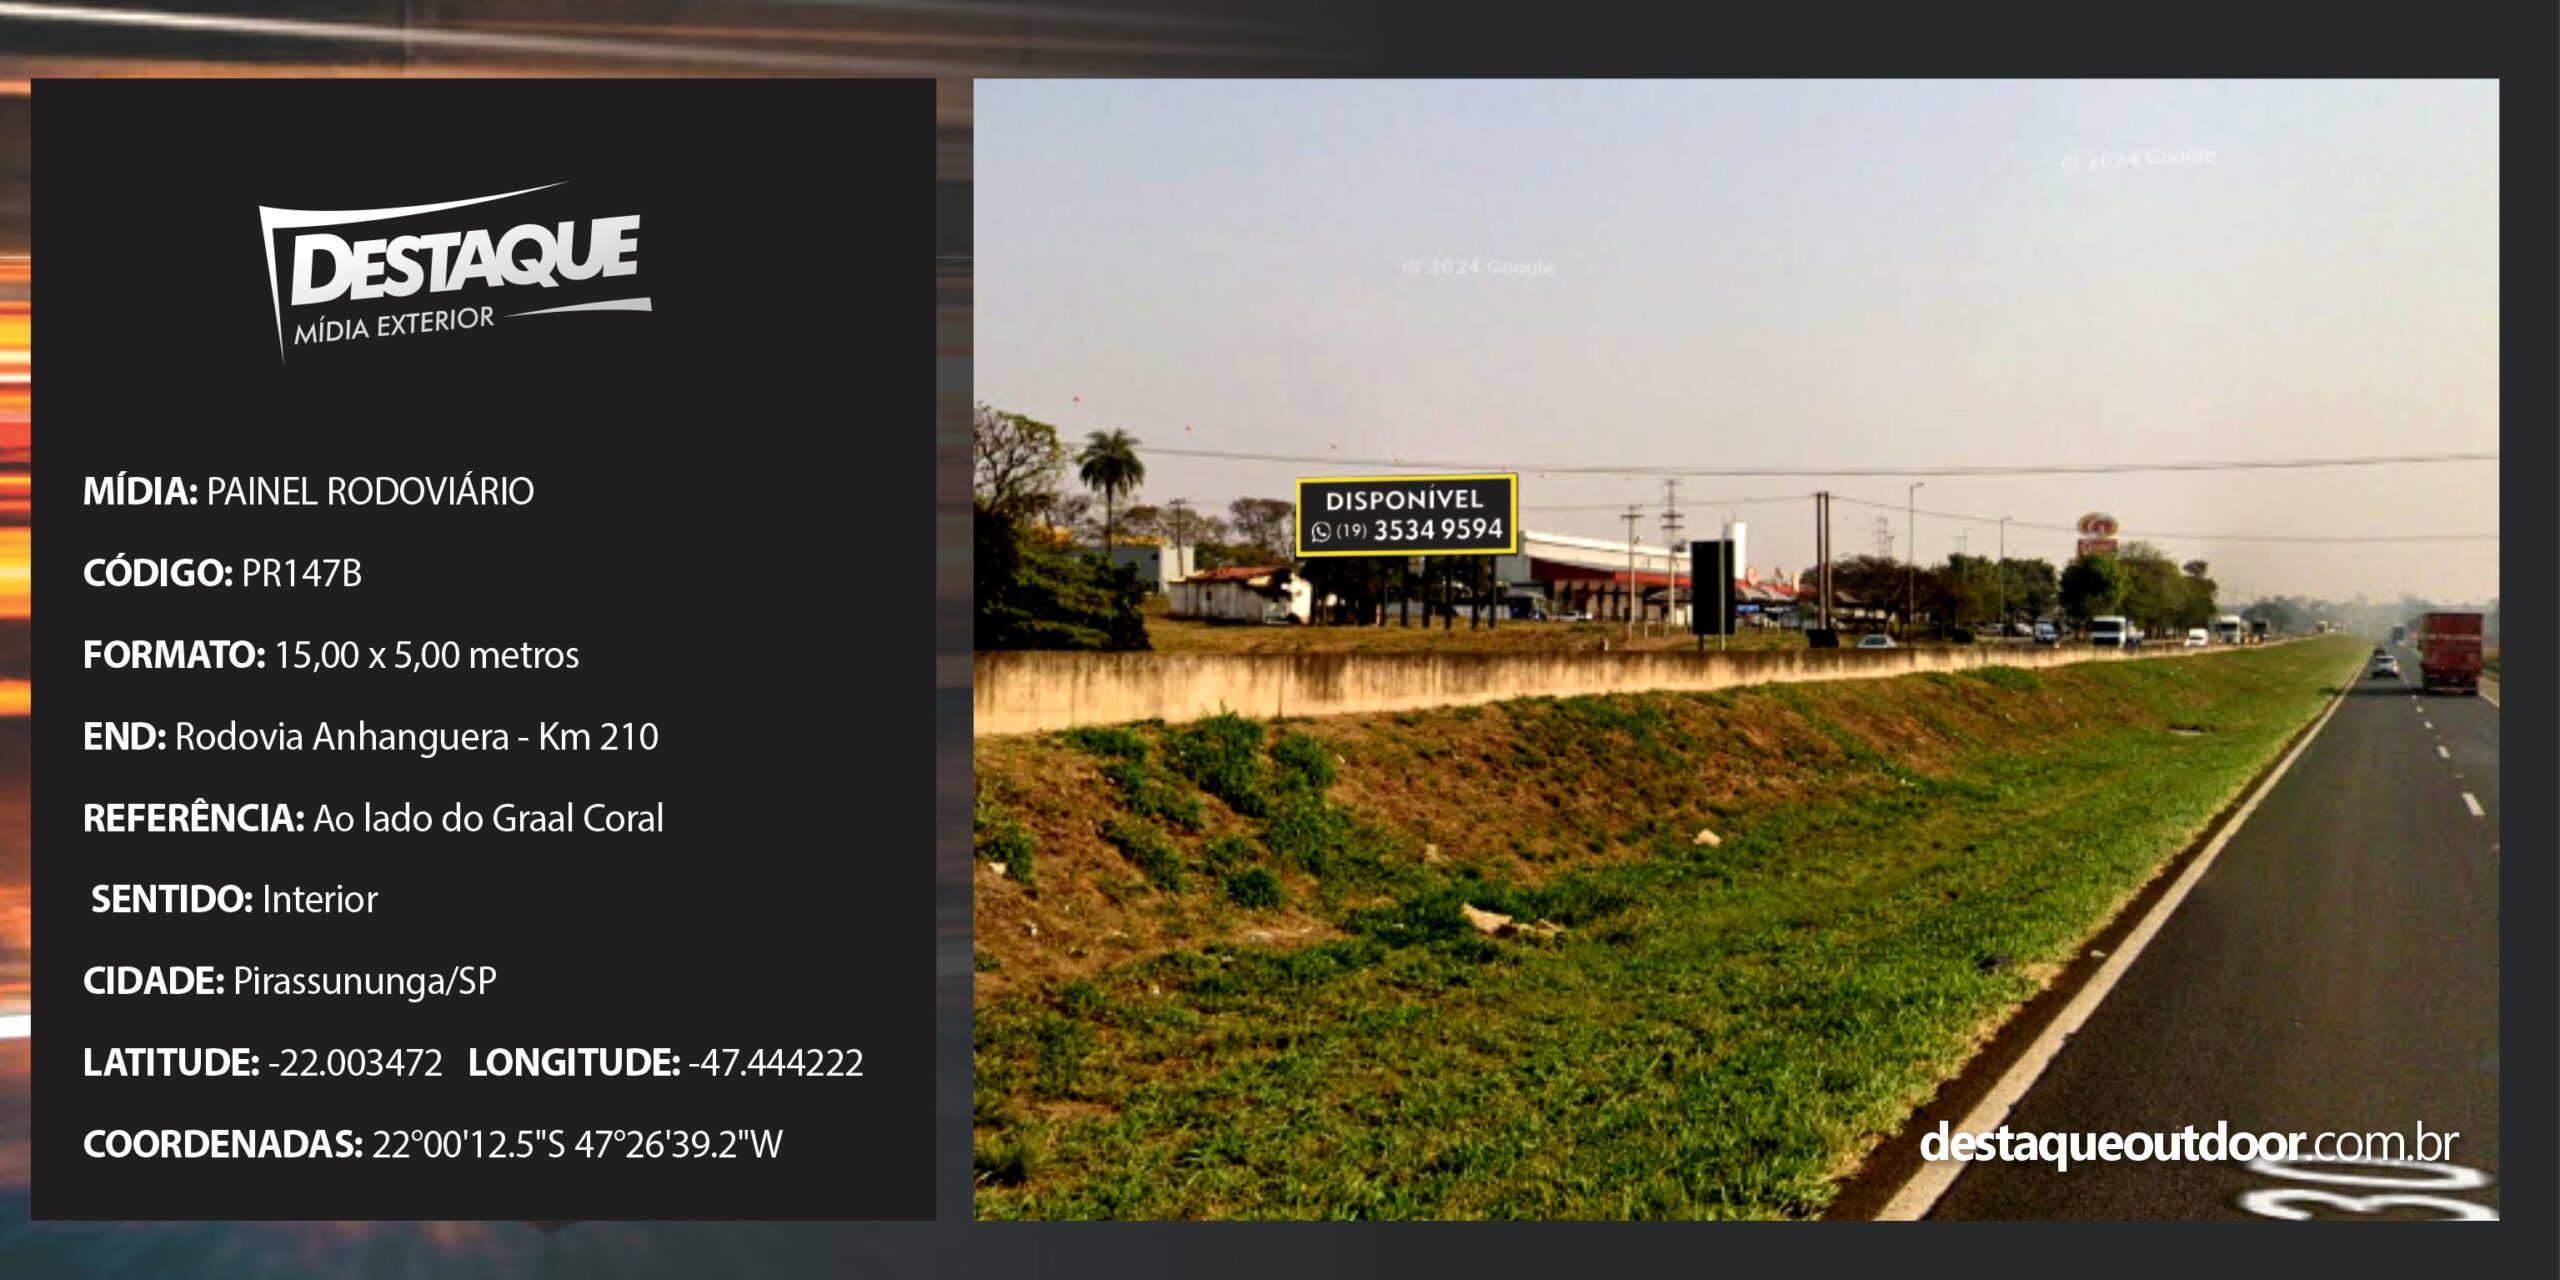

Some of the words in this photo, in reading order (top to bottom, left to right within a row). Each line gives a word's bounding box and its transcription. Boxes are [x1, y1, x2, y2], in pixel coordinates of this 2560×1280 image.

[1326, 484, 1484, 511] DISPONÍVEL
[1336, 523, 1367, 540] (19)
[1374, 519, 1435, 541] 3534
[1441, 518, 1503, 539] 9594
